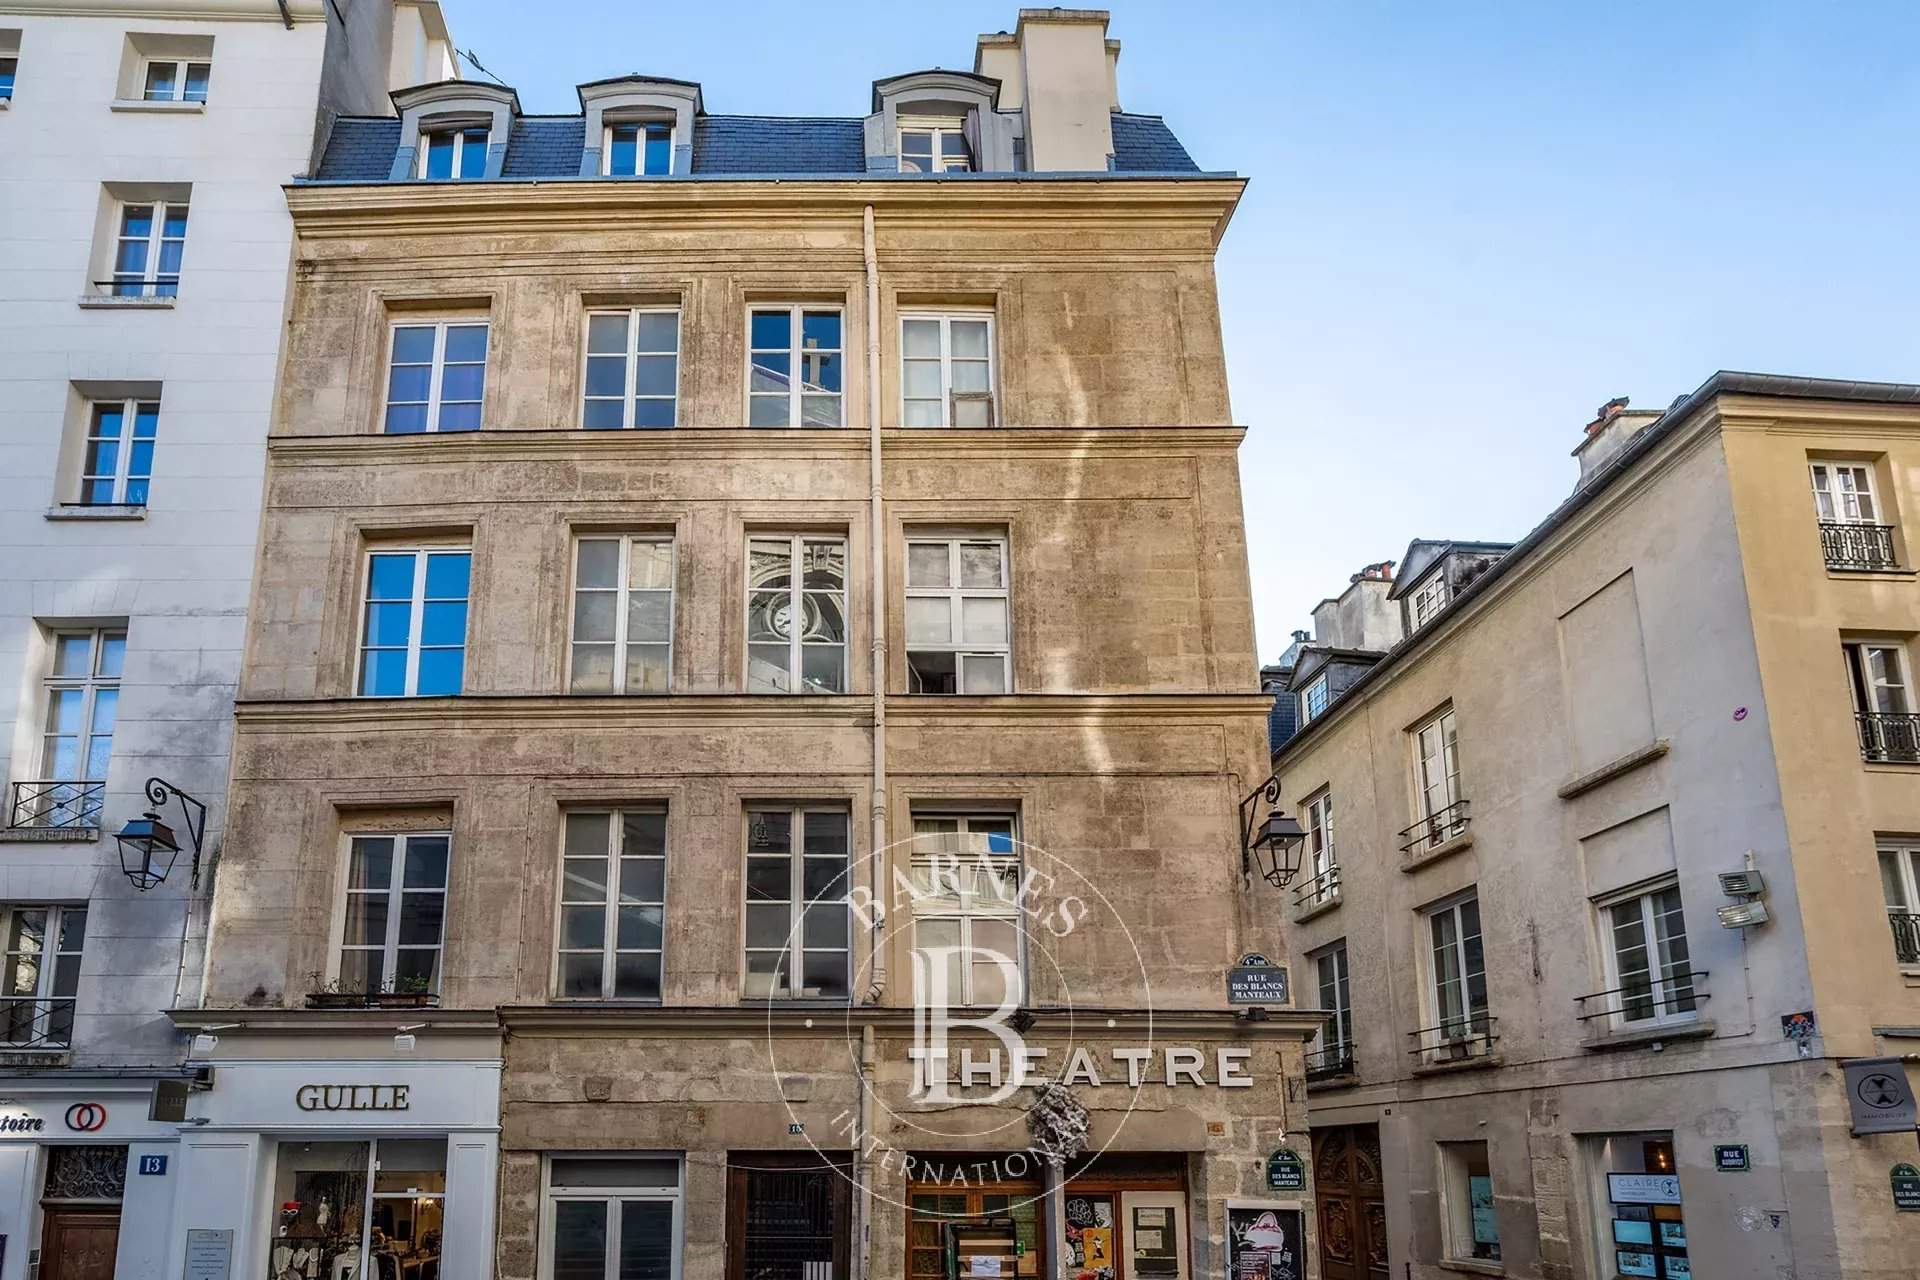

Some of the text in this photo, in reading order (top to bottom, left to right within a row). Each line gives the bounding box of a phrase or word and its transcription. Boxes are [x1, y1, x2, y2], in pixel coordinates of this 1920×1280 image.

[1247, 974, 1267, 982] RUE
[1235, 991, 1281, 999] MANTEAUX
[908, 1047, 1254, 1087] THEATRE
[296, 1084, 410, 1112] GULLE
[1722, 1150, 1740, 1158] RUE
[144, 1156, 161, 1172] 13
